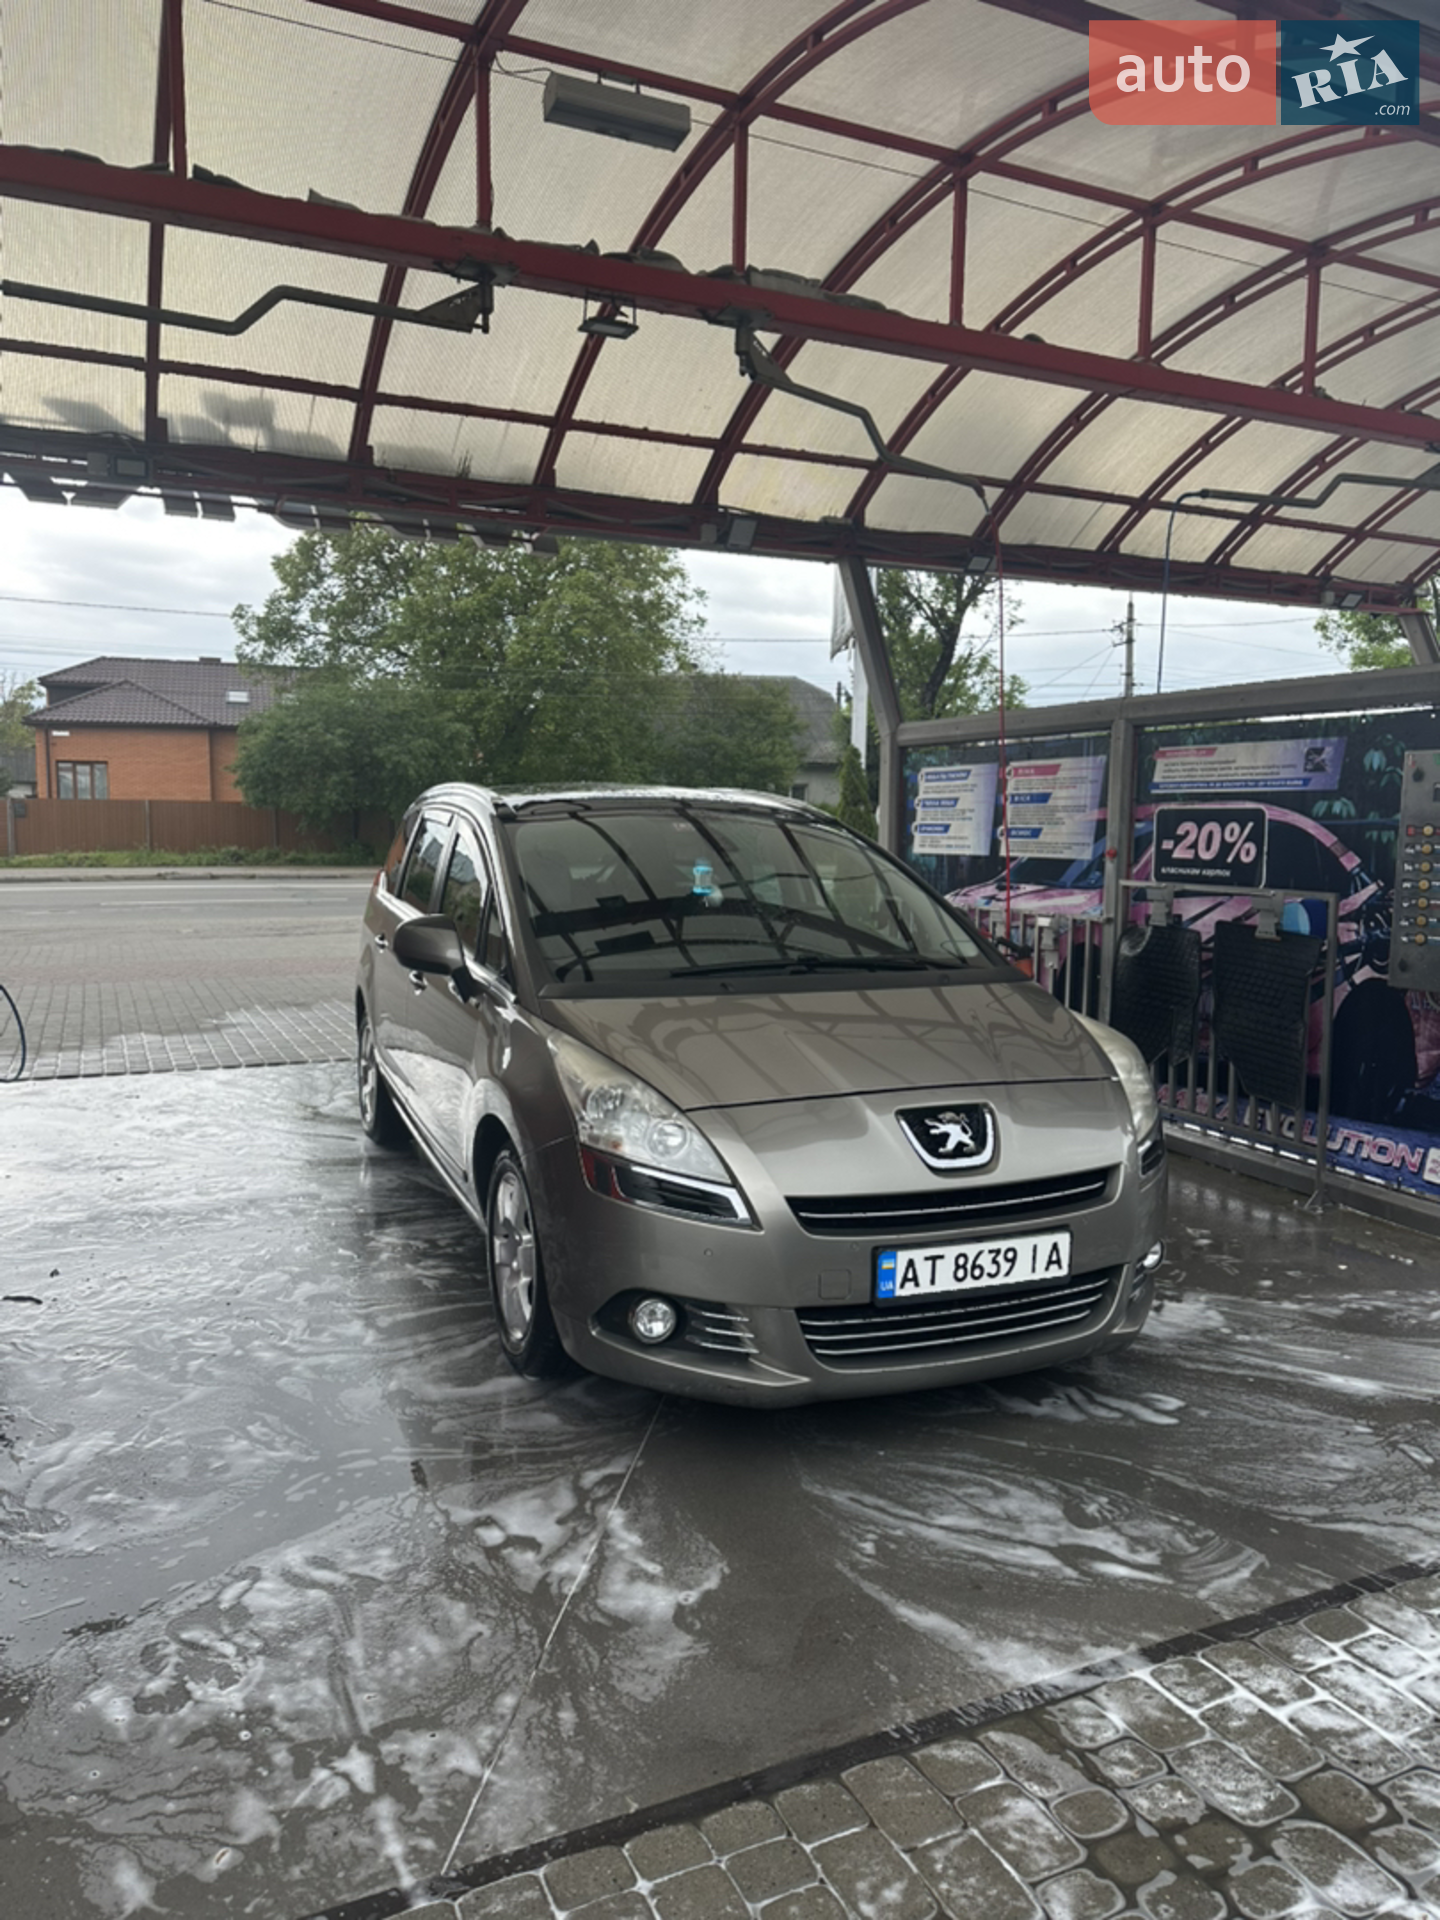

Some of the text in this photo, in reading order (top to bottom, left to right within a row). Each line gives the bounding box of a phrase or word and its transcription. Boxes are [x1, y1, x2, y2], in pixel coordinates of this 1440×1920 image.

[1161, 821, 1257, 863] -20%
[880, 1280, 894, 1291] UA
[900, 1241, 1063, 1289] AT 8639 IA
